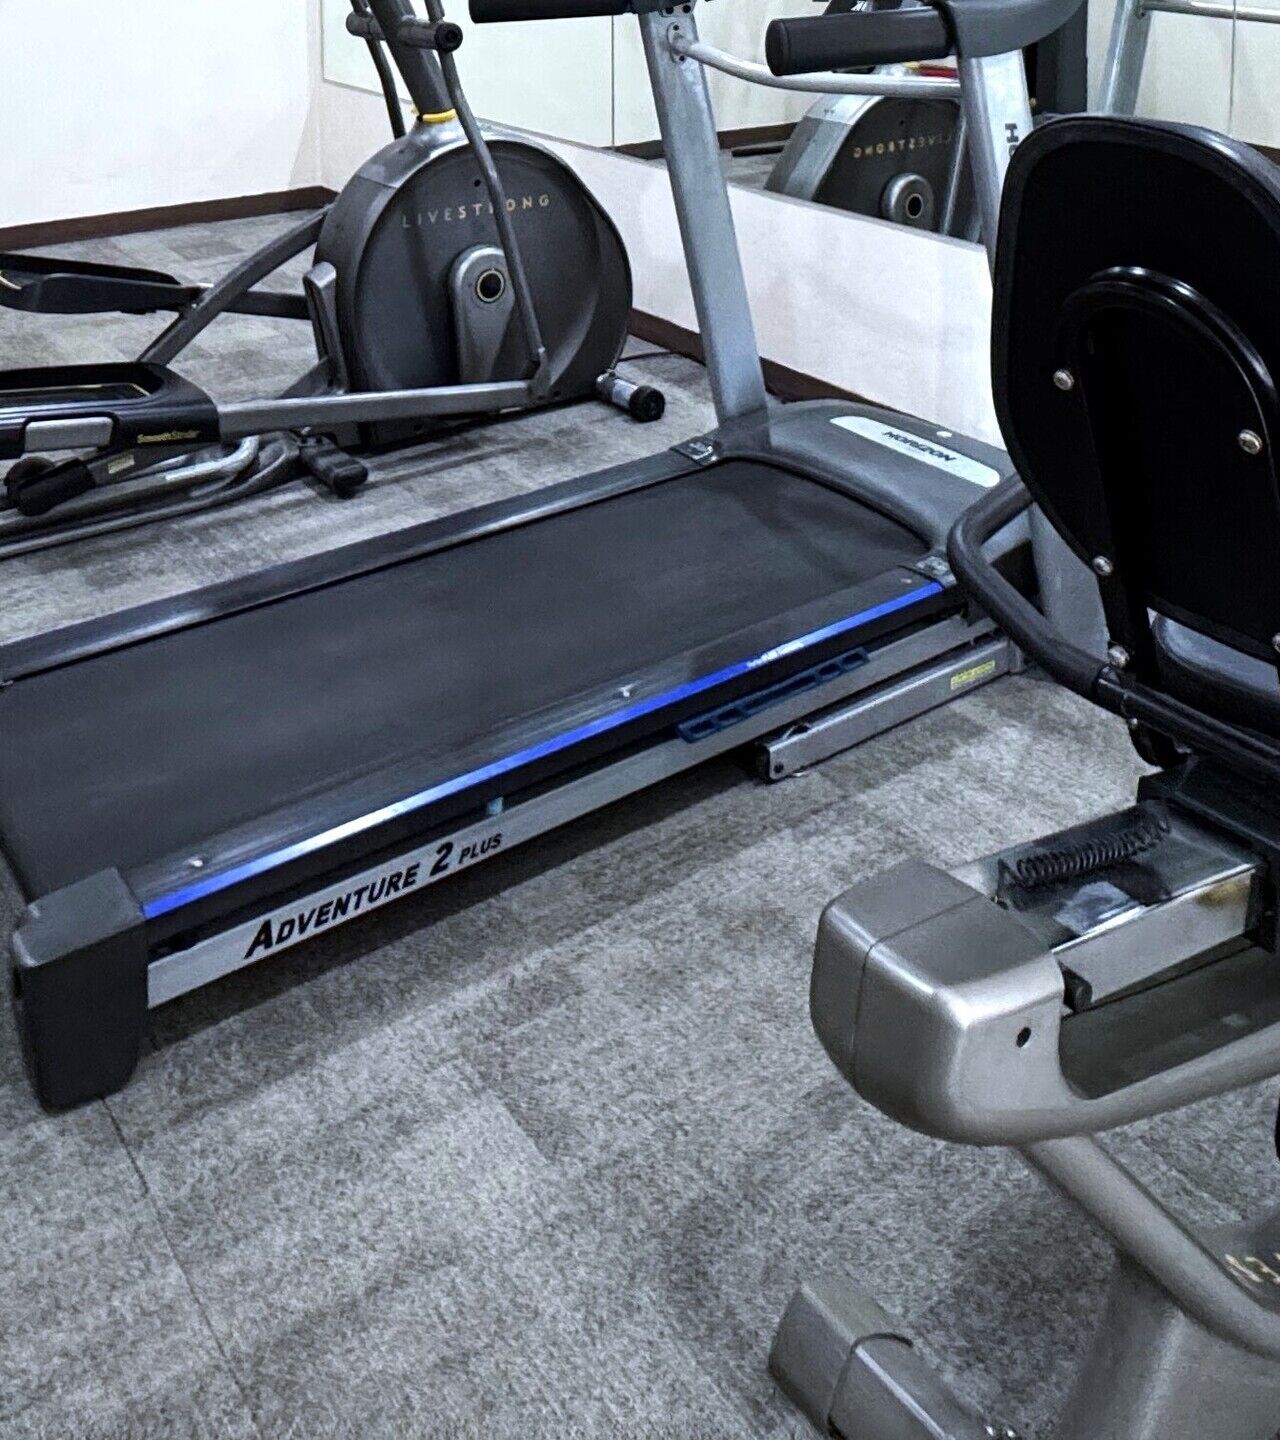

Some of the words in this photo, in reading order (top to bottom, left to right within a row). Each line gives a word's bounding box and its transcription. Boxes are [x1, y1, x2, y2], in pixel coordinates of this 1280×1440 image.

[243, 861, 421, 960] ADVENTURE
[428, 840, 455, 878] 2
[458, 832, 503, 864] PLUS
